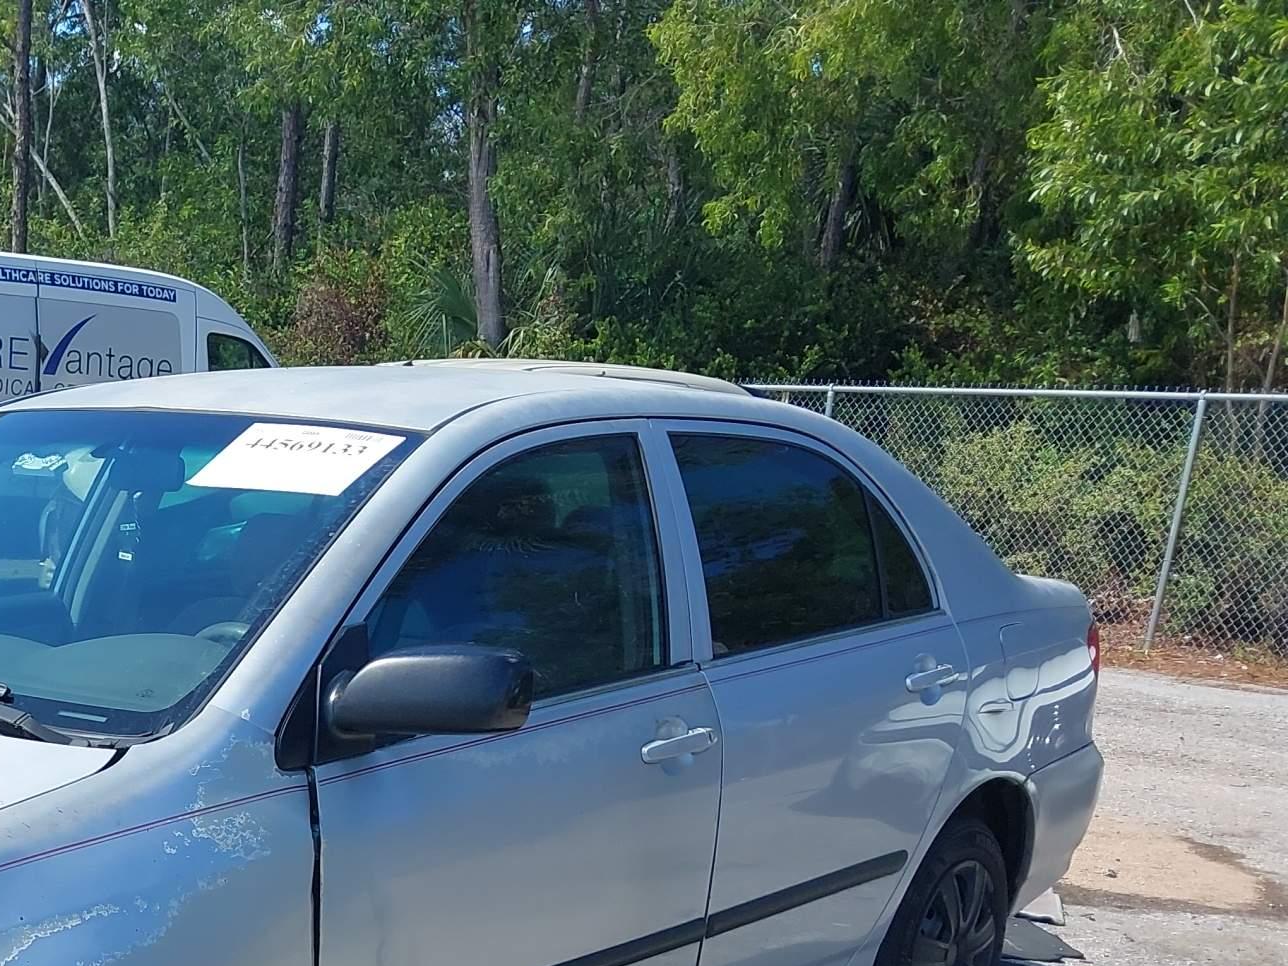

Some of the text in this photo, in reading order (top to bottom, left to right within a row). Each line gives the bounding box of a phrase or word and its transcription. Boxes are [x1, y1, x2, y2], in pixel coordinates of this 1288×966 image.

[53, 273, 115, 292] SOLUTIONS
[117, 282, 139, 295] FOR
[142, 286, 175, 301] TODAY
[245, 437, 368, 456] 44569133
